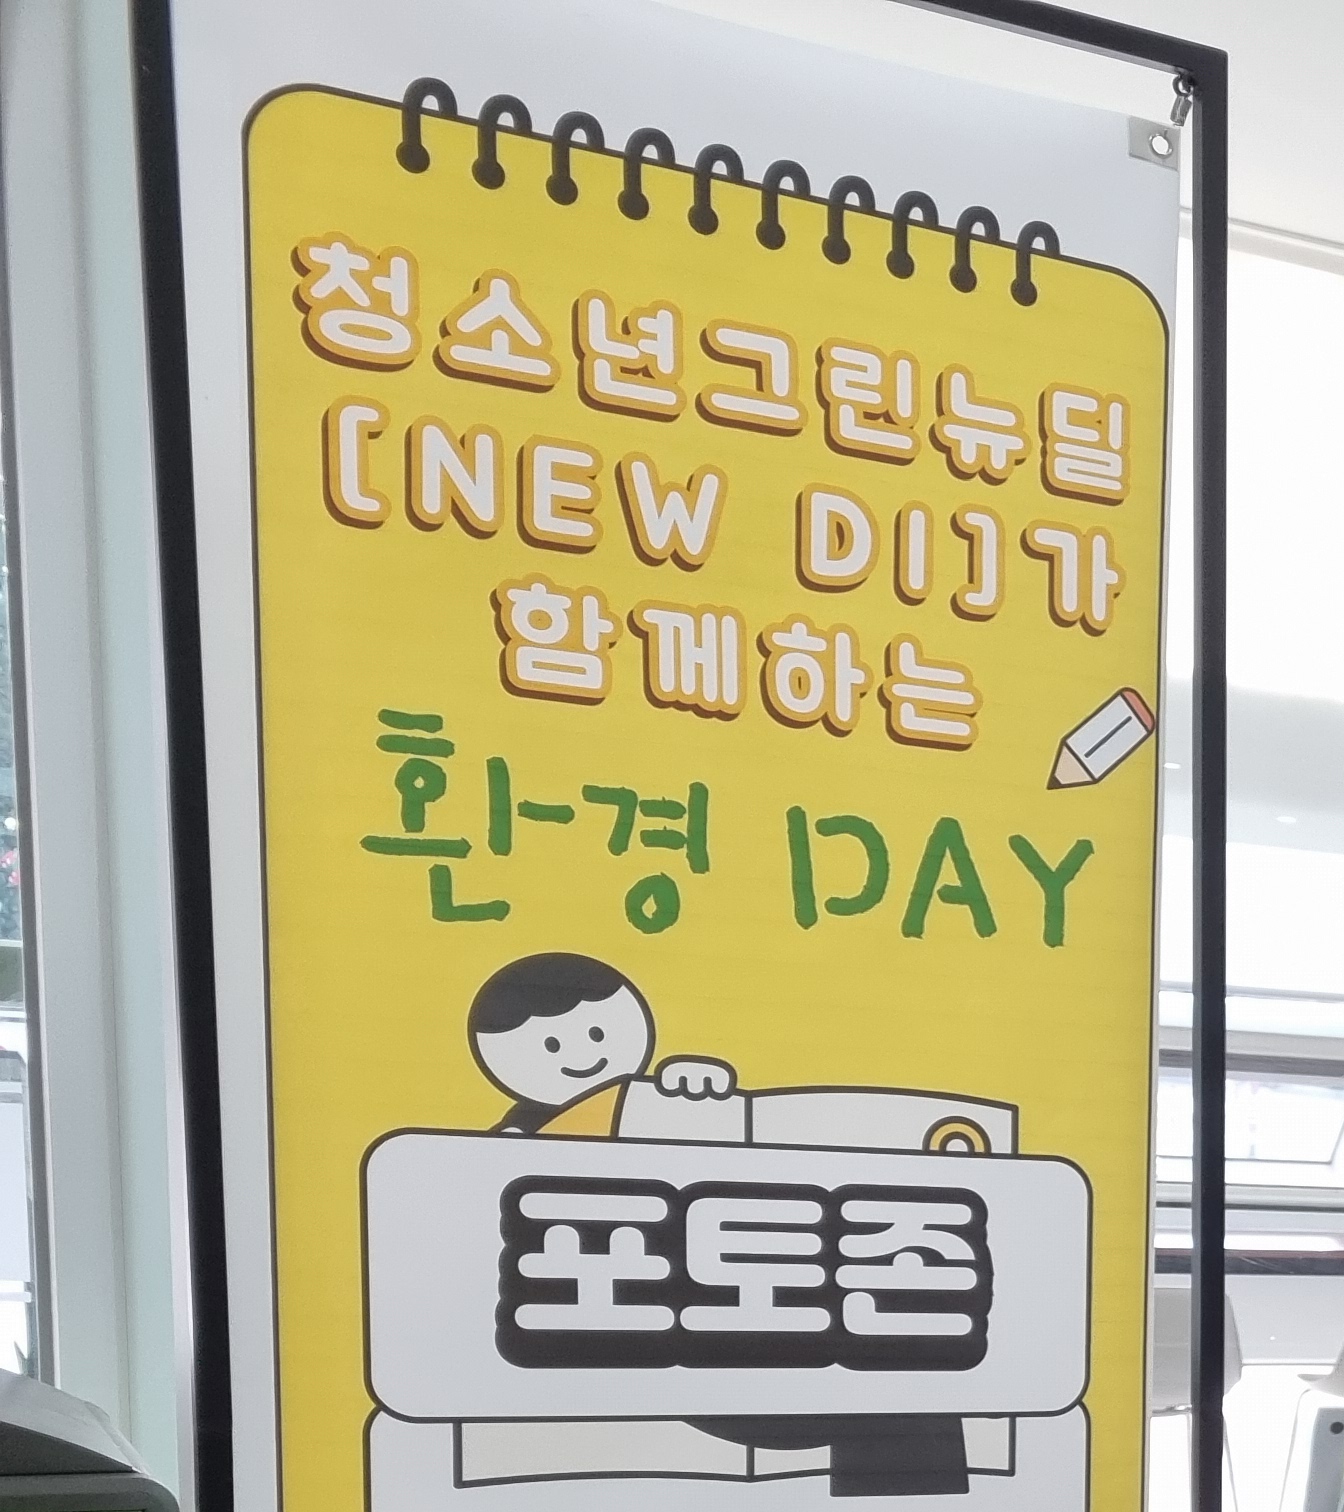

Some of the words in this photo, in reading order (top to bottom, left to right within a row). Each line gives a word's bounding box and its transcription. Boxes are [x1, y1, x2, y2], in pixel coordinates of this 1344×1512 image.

[292, 231, 1130, 503] 청소년그린뉴딜
[323, 394, 727, 570] [NEW
[795, 484, 1127, 633] DI]가
[493, 572, 981, 750] 함께하는
[360, 708, 709, 934] 환경
[786, 805, 1093, 947] DAY
[495, 1175, 994, 1370] 포토존
